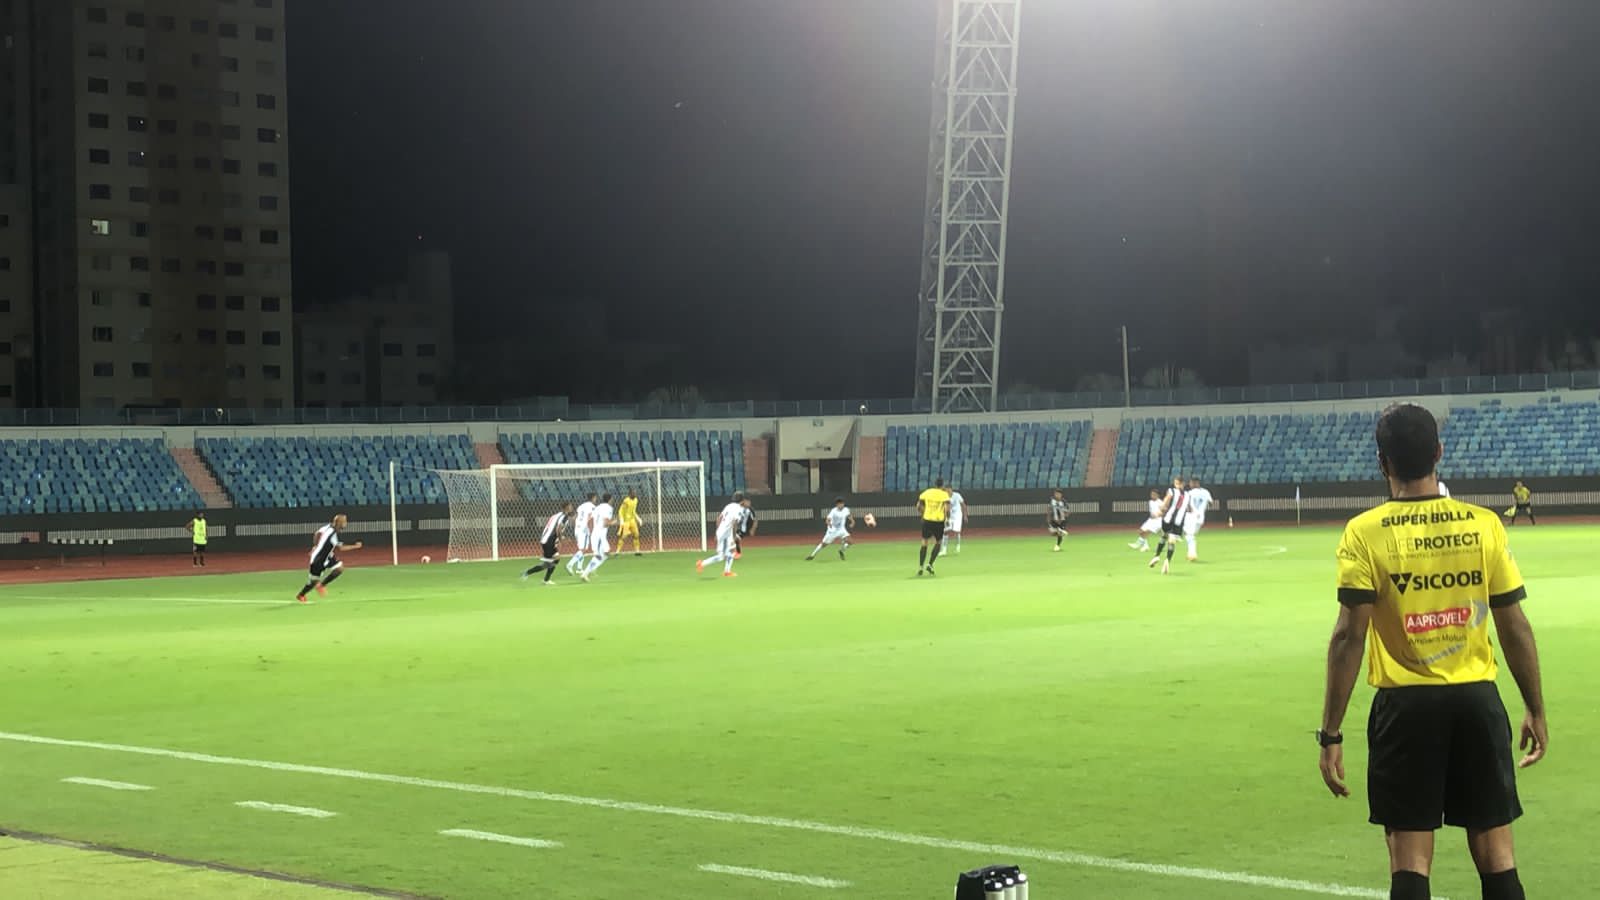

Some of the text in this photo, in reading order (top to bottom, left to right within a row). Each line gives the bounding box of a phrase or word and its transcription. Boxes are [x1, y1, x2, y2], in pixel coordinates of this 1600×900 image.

[1381, 510, 1475, 528] SUPER BOLLA
[1386, 532, 1481, 552] LIFEPROTECT
[1412, 570, 1483, 591] SICOOB
